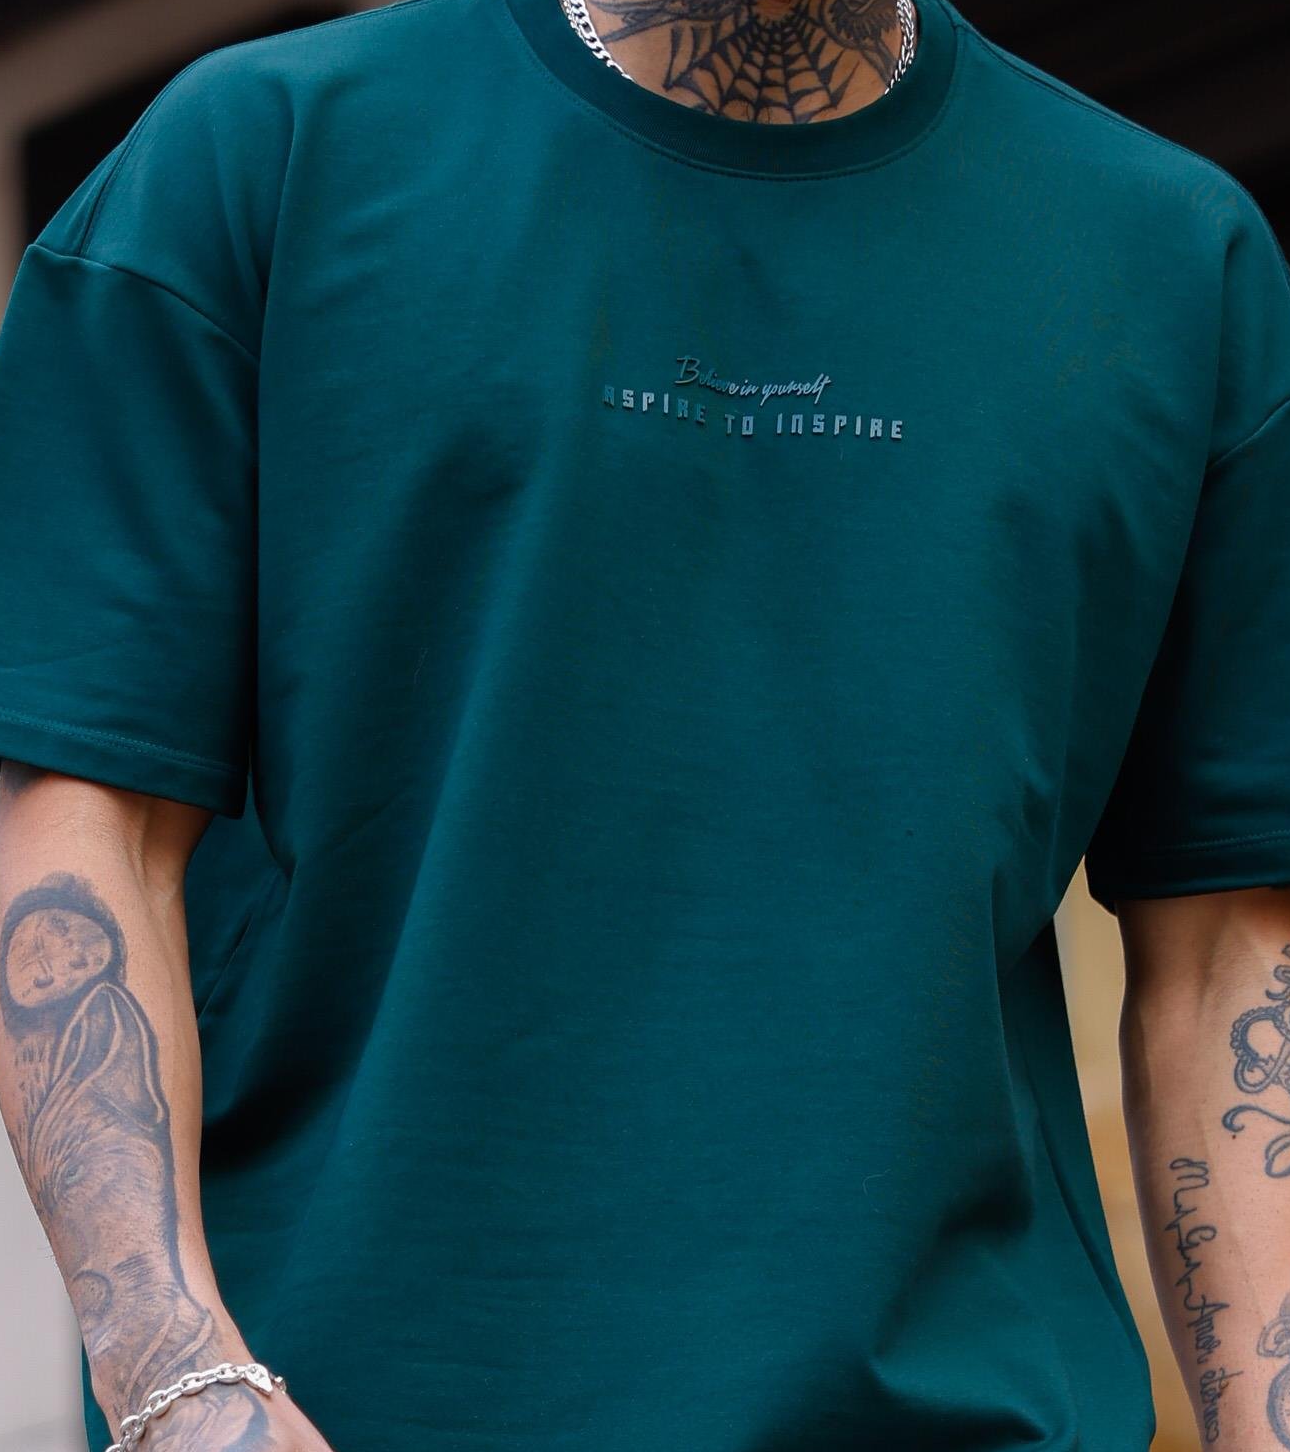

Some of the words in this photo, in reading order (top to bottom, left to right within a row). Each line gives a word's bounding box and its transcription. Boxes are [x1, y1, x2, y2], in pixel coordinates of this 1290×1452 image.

[603, 384, 707, 424] ASPIRE
[724, 413, 755, 436] TO
[776, 413, 903, 440] INSPIRE
[740, 379, 759, 397] in
[759, 373, 831, 407] yourself
